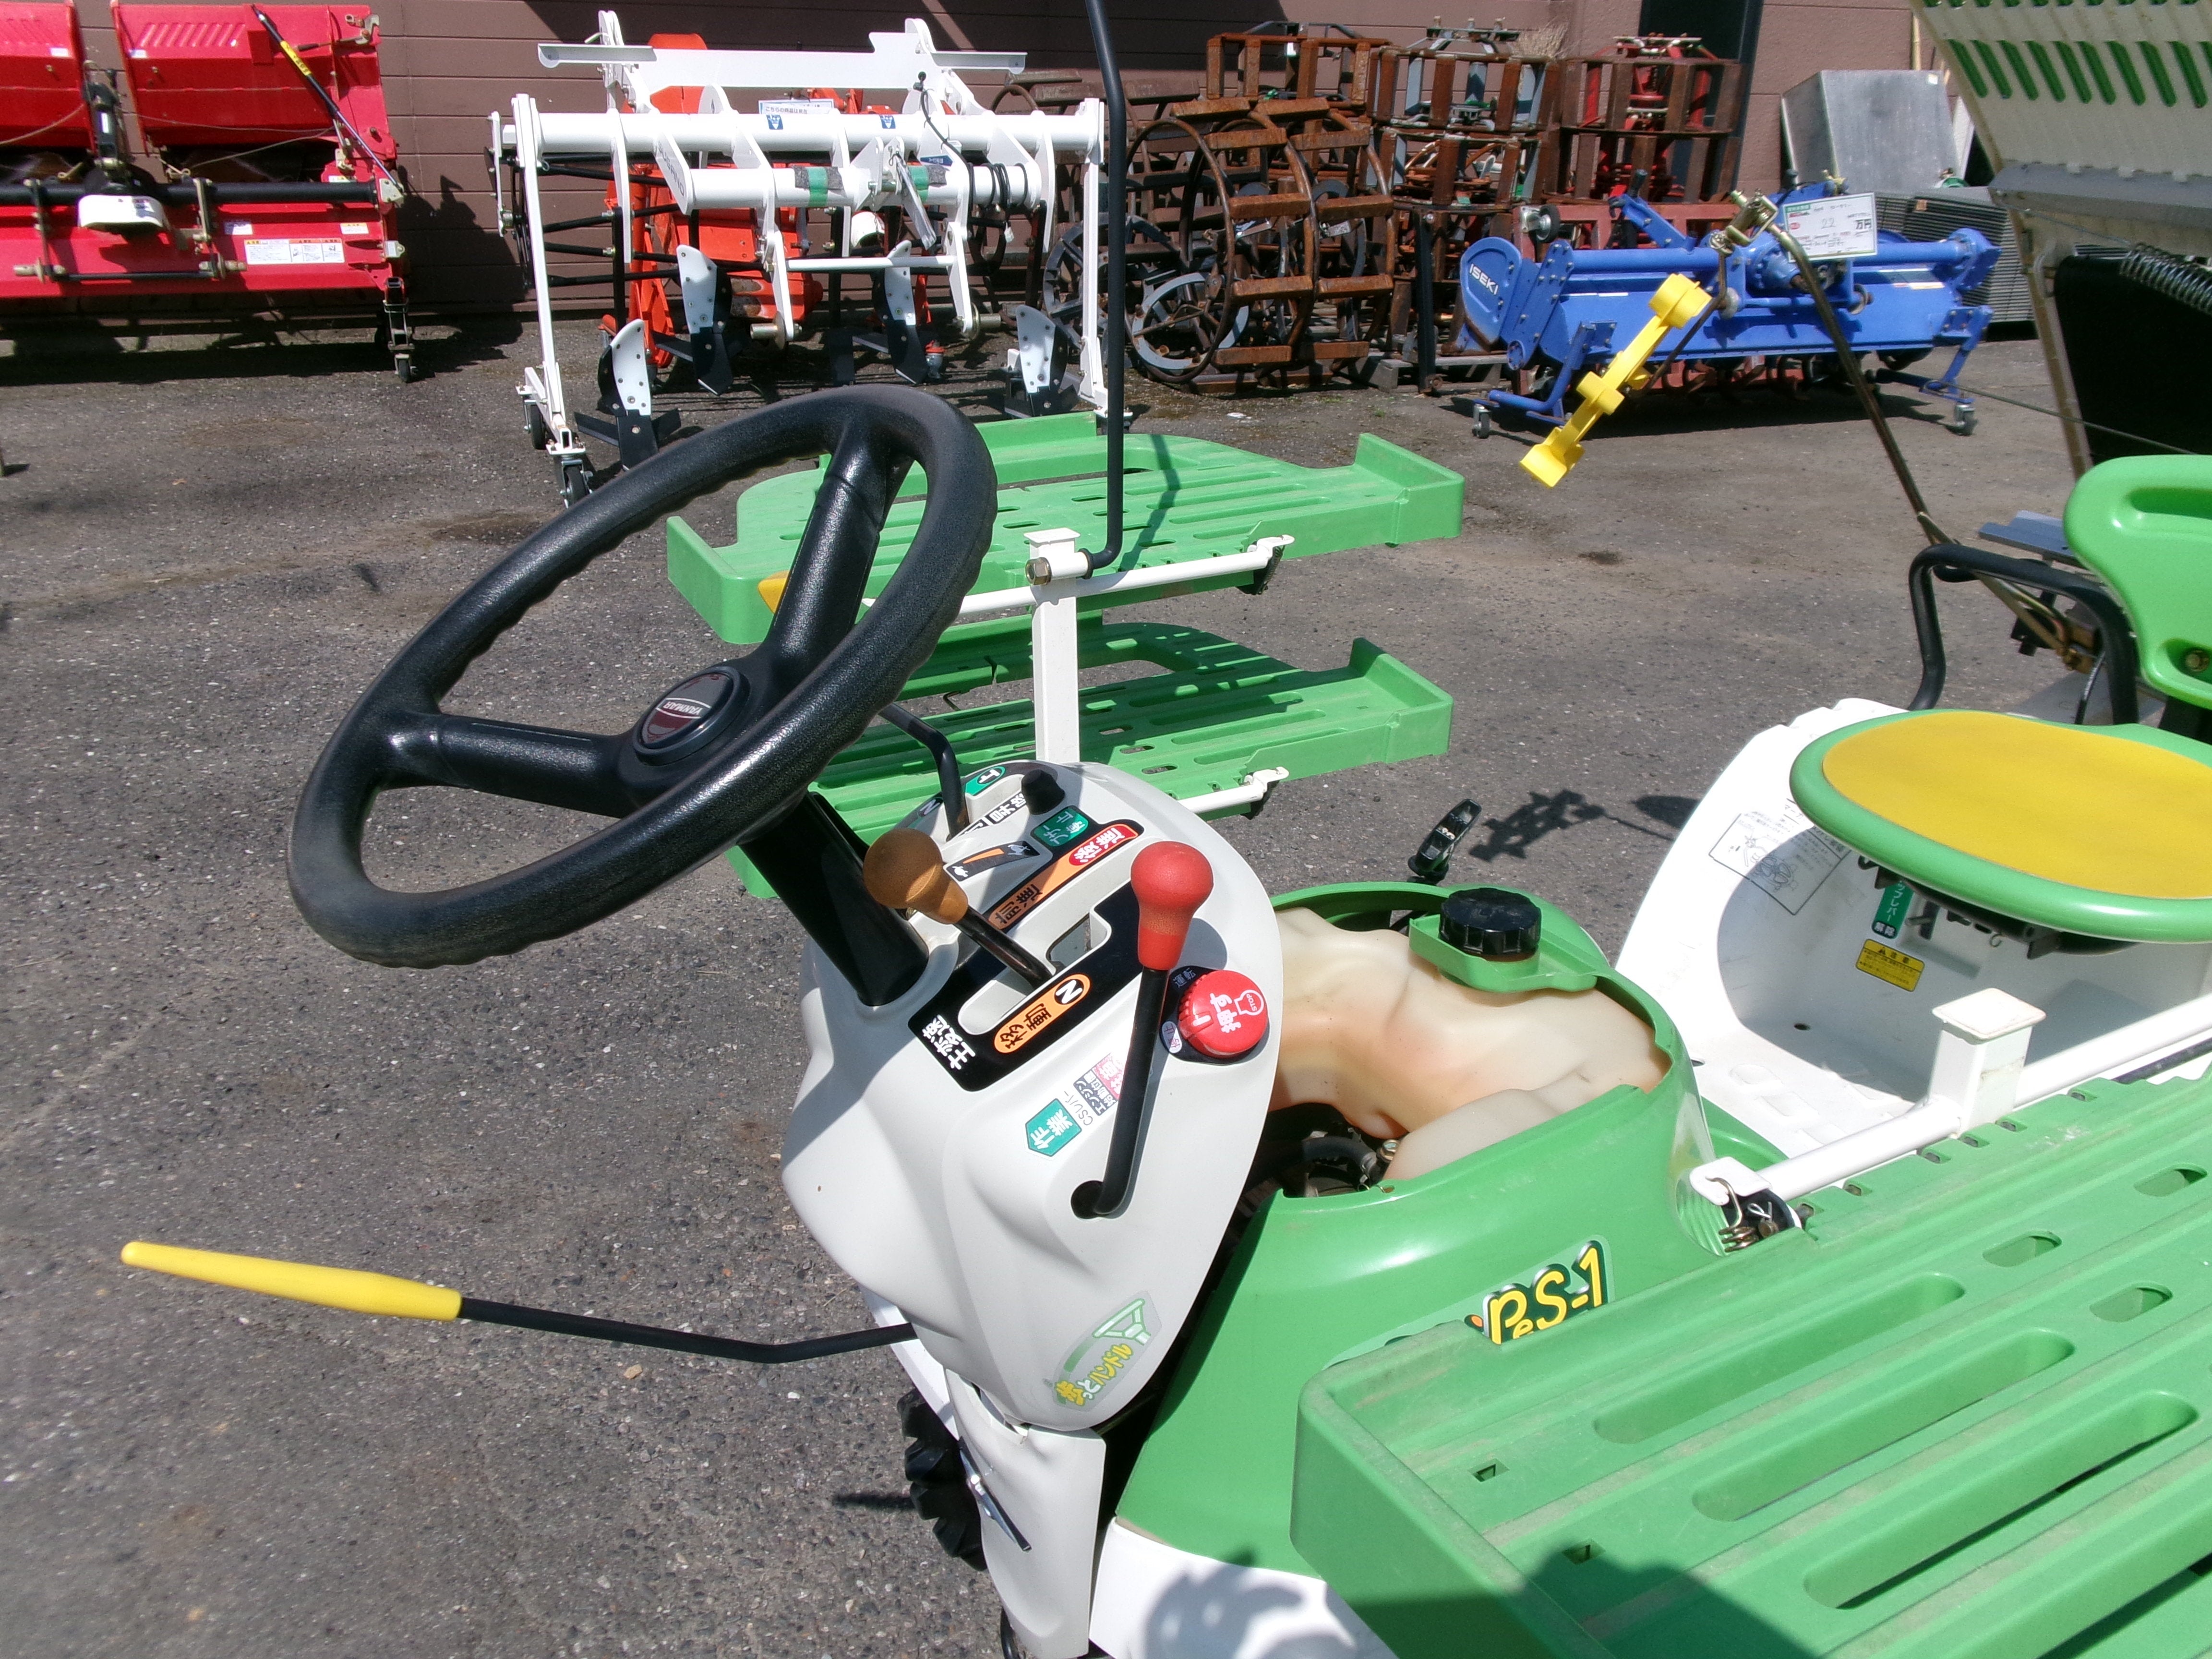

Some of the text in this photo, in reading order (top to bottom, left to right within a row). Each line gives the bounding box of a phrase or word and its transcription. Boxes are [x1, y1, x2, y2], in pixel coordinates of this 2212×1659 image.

[1469, 263, 1498, 295] ISEKI
[662, 701, 703, 715] YANMAR
[1043, 824, 1069, 845] ブザー
[1056, 810, 1085, 834] 停止
[1073, 827, 1125, 863] 後進
[995, 883, 1043, 925] 前進
[1055, 979, 1083, 1004] N
[1172, 967, 1196, 988] 運転
[1209, 992, 1242, 1034] 押す
[1246, 993, 1258, 1011] STOP
[922, 1014, 976, 1070] 主変速
[999, 1003, 1052, 1049] 移動
[1164, 1023, 1181, 1048] 停止
[1076, 1080, 1107, 1115] エンジン
[1083, 1070, 1117, 1107] 始動位置
[1064, 1090, 1094, 1126] CSレバー
[1030, 1108, 1073, 1149] 作業
